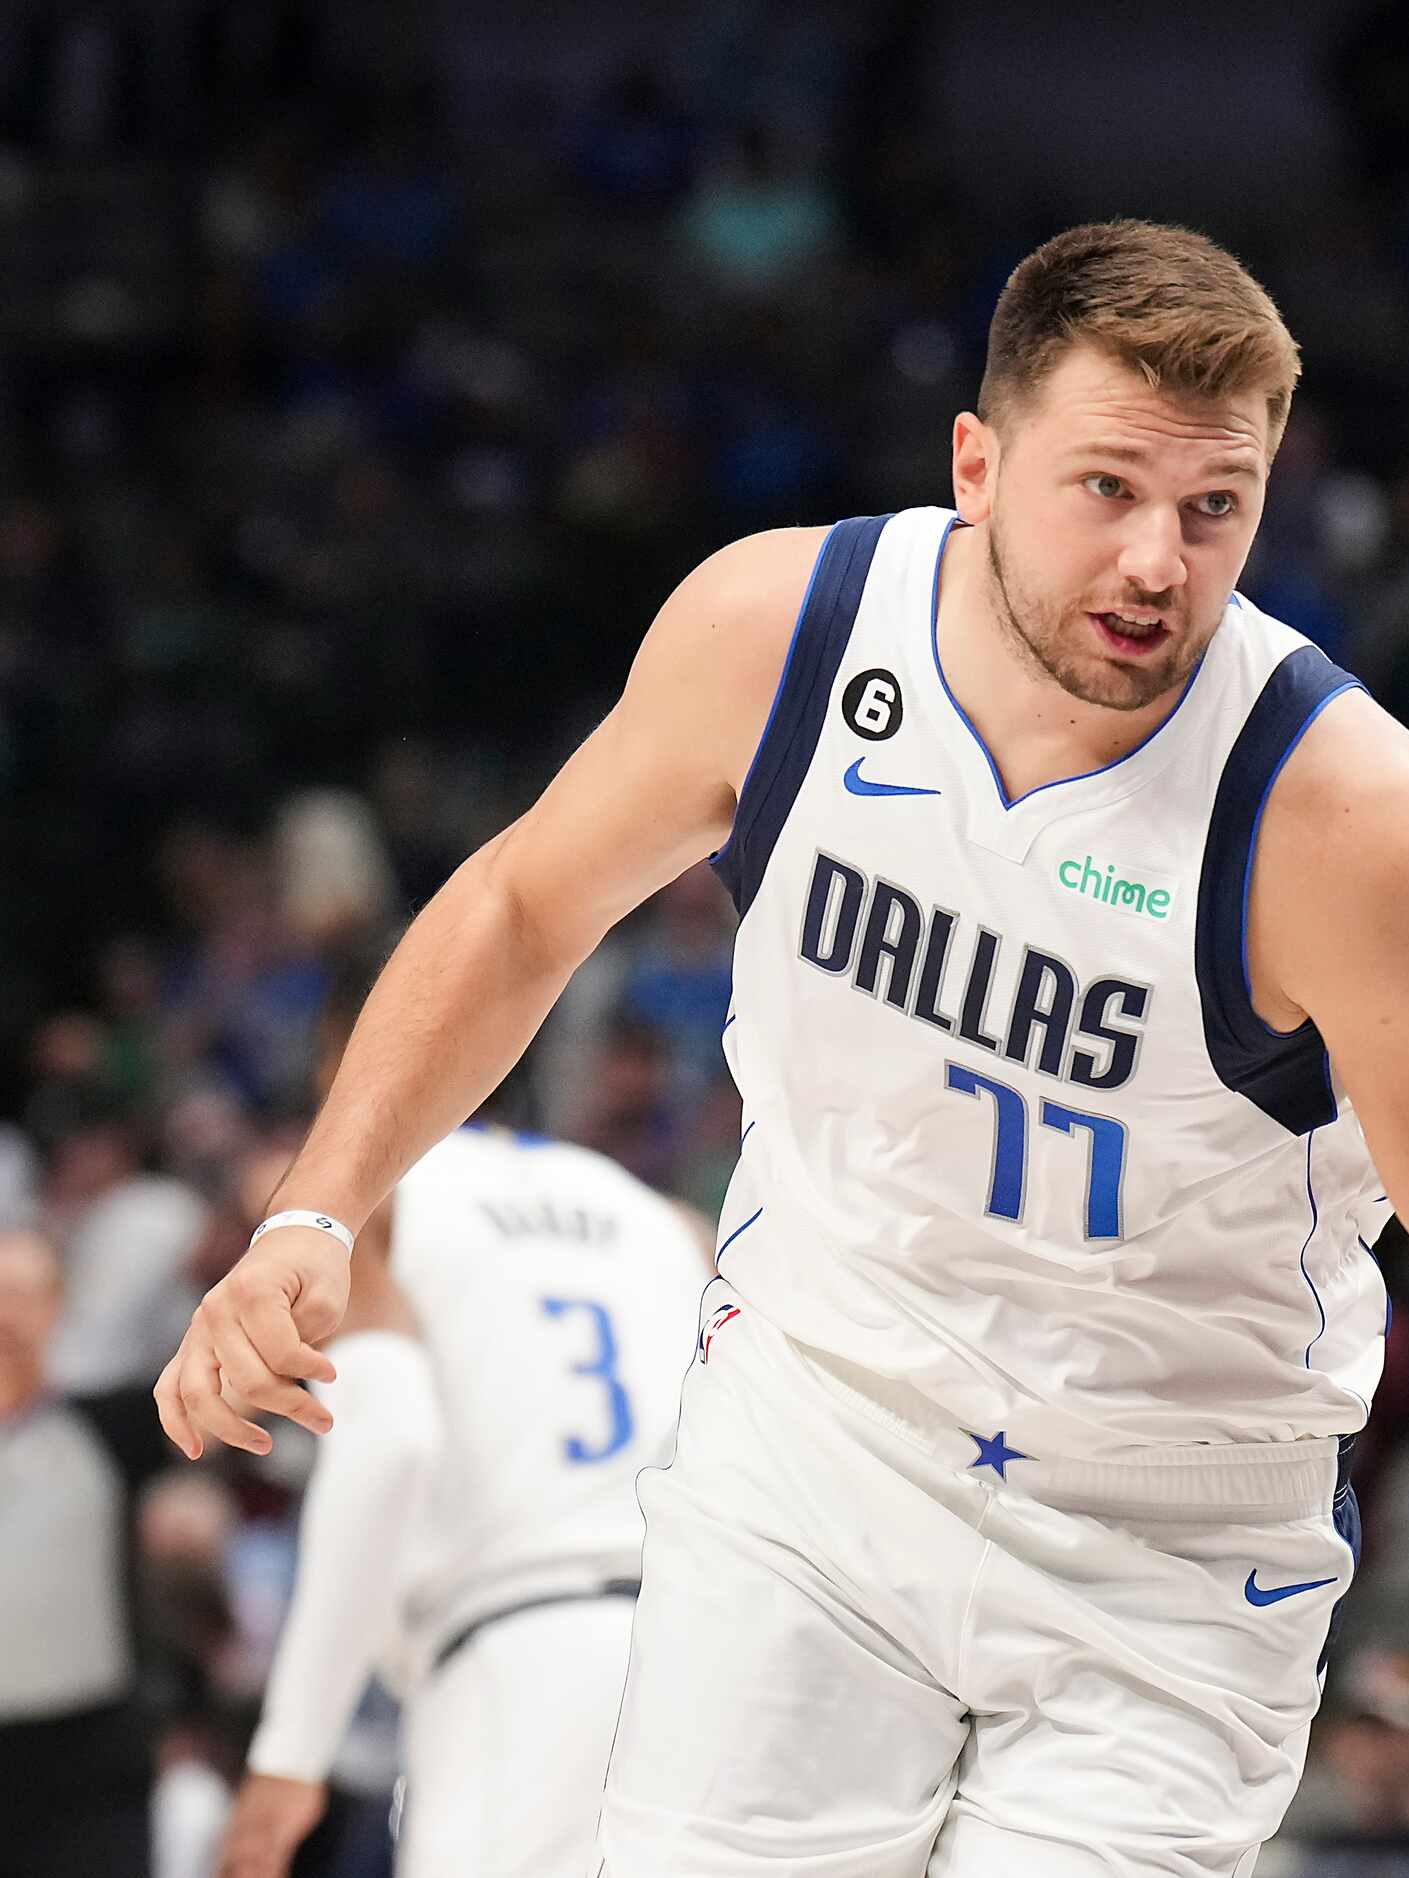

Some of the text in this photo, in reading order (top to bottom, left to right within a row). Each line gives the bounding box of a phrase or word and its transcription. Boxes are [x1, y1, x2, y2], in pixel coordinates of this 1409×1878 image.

[853, 676, 896, 735] 6
[797, 846, 1155, 1094] DALLAS
[1058, 855, 1171, 919] chime
[943, 1058, 1129, 1242] 77
[541, 1297, 637, 1466] 3
